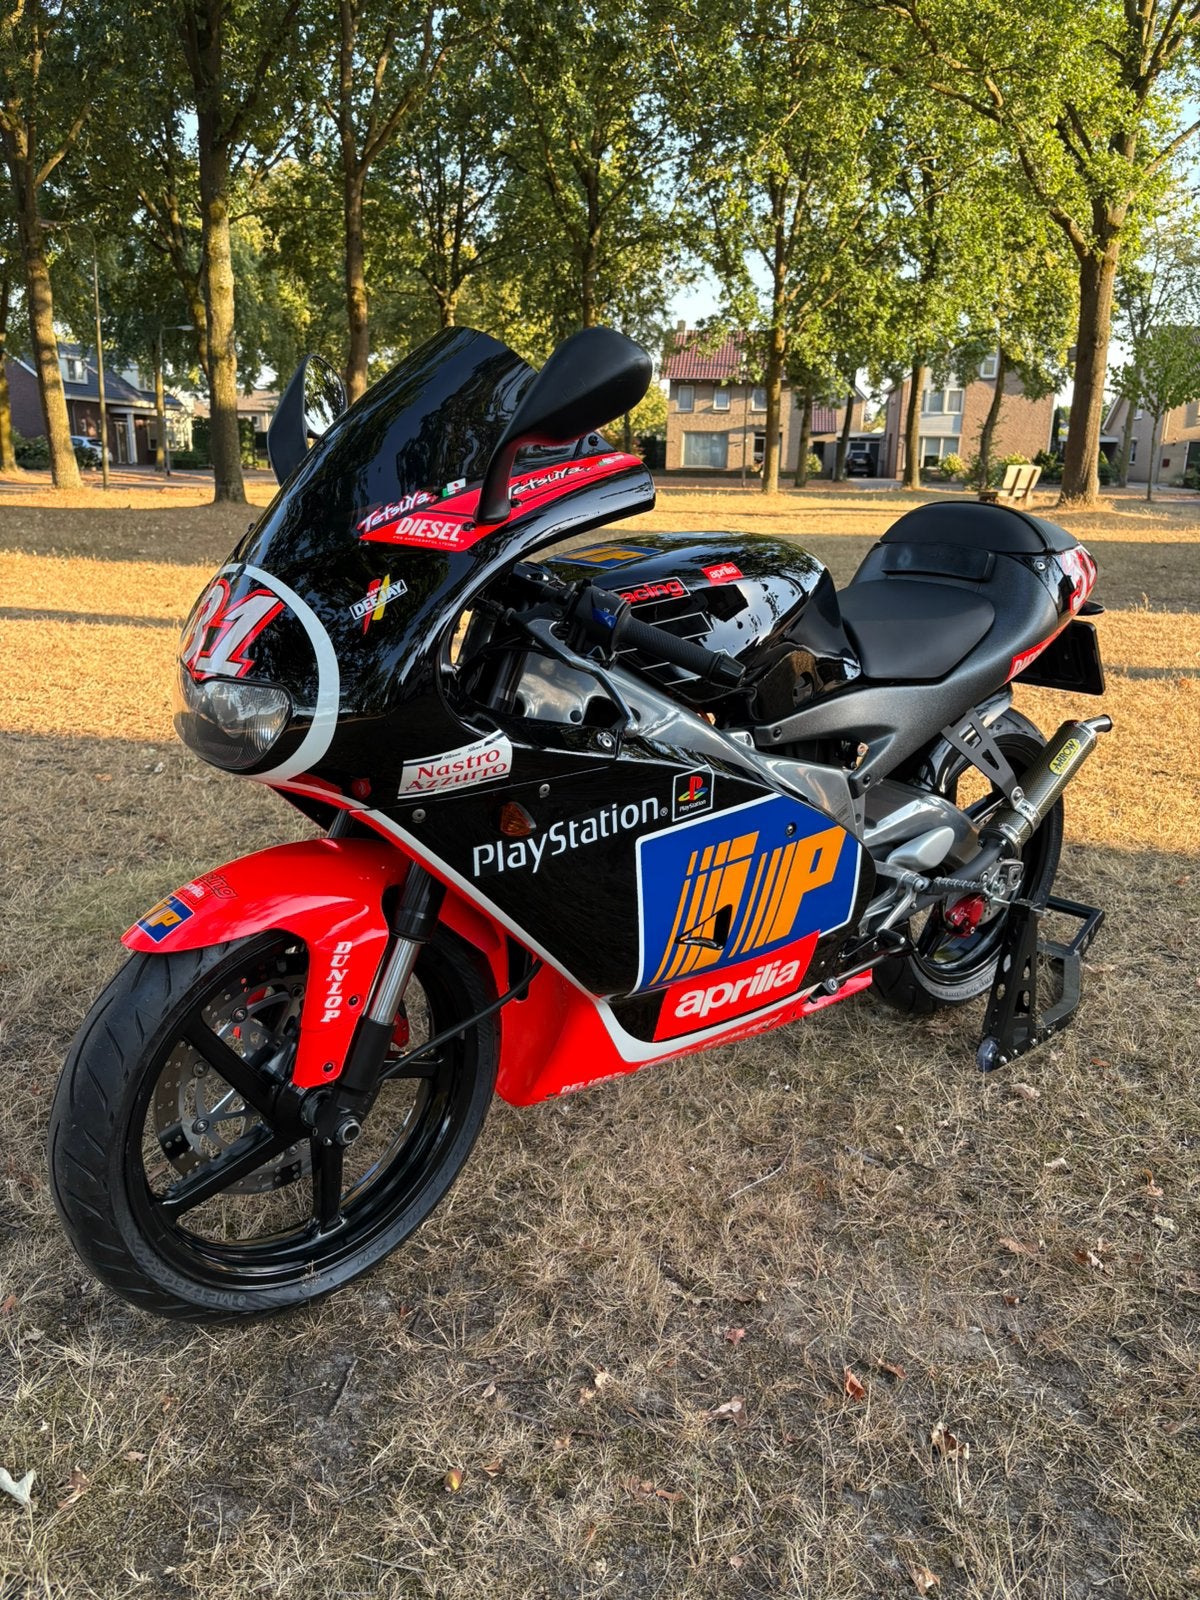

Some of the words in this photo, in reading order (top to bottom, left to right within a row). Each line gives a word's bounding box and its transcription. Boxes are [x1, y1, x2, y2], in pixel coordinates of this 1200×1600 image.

[395, 516, 462, 542] DIESEL
[709, 565, 737, 579] aprilia
[619, 580, 685, 605] acing
[417, 749, 500, 780] Nastro
[1053, 739, 1076, 770] ARROW
[405, 762, 507, 791] Azzurro
[679, 799, 707, 812] PlayStation
[320, 941, 353, 1023] DUNLOP
[674, 960, 800, 1018] aprilia
